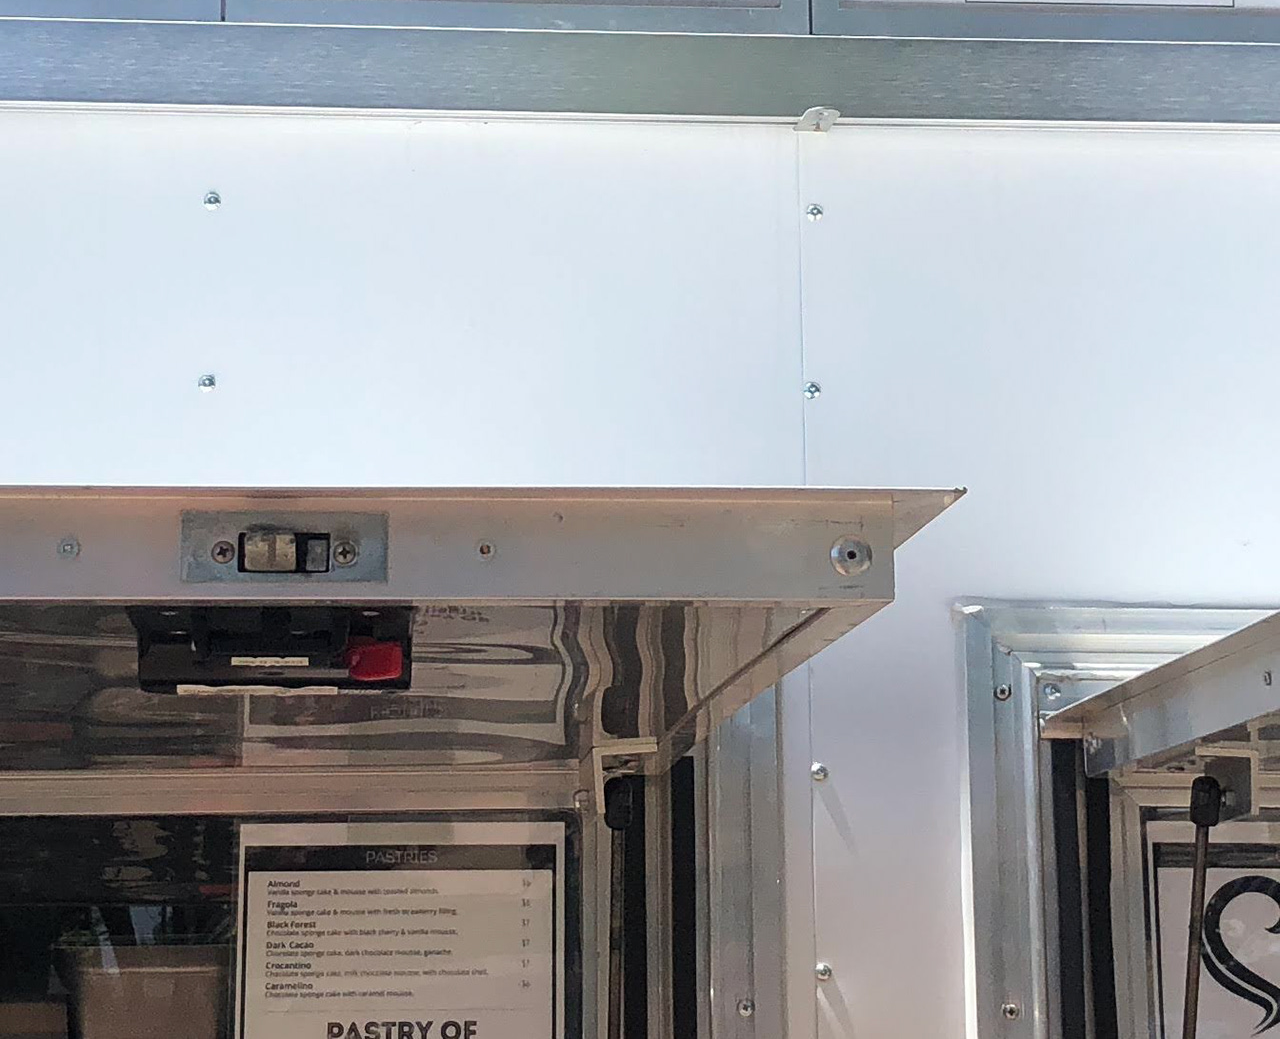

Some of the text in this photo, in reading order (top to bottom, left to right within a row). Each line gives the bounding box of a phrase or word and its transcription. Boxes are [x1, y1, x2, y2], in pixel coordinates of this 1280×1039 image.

[365, 849, 439, 864] PASTRIES
[326, 1020, 477, 1039] PASTRY OF
